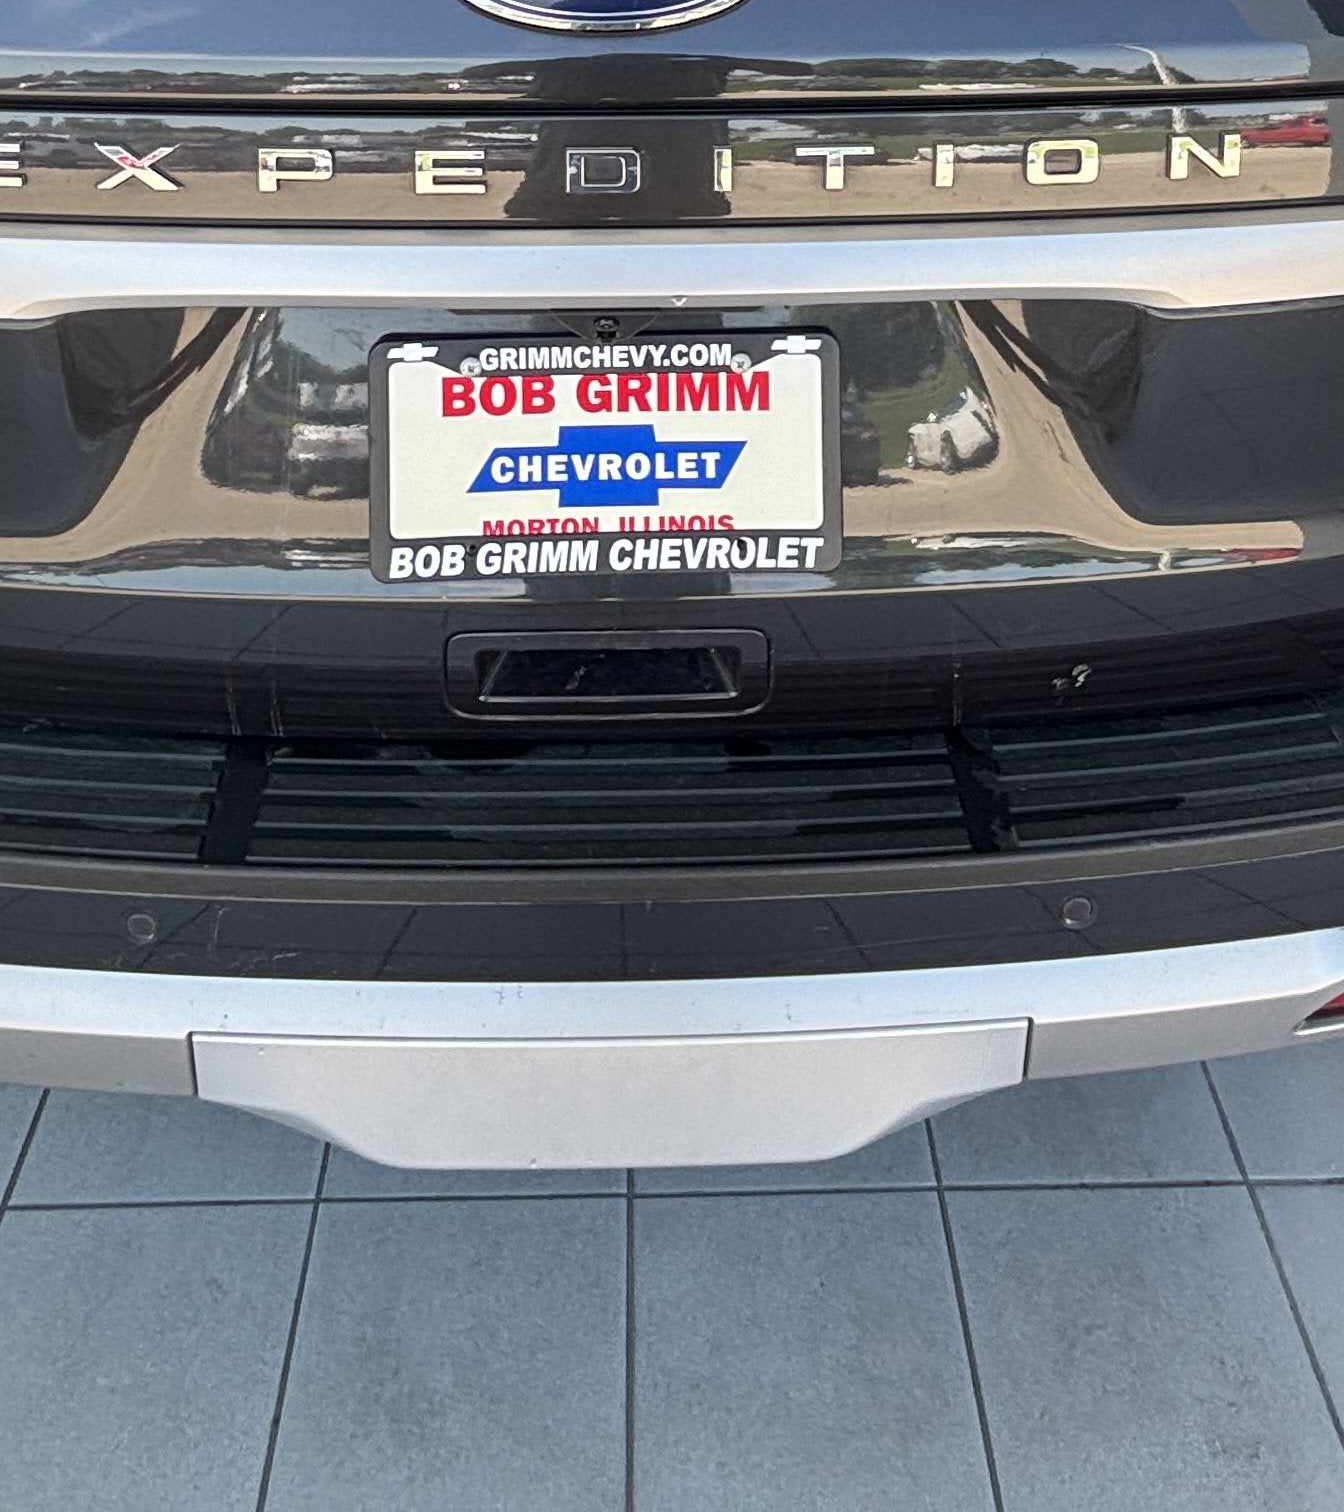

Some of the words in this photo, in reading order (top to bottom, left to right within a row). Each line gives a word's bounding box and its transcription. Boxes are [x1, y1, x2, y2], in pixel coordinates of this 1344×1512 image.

[479, 343, 732, 371] GRIMMCHEVY.COM
[441, 375, 557, 418] BOB
[576, 370, 771, 414] GRIMM
[489, 451, 722, 484] CHEVROLET
[388, 545, 466, 579] BOB
[475, 539, 599, 574] GRIMM
[608, 536, 825, 571] CHEVROLET
